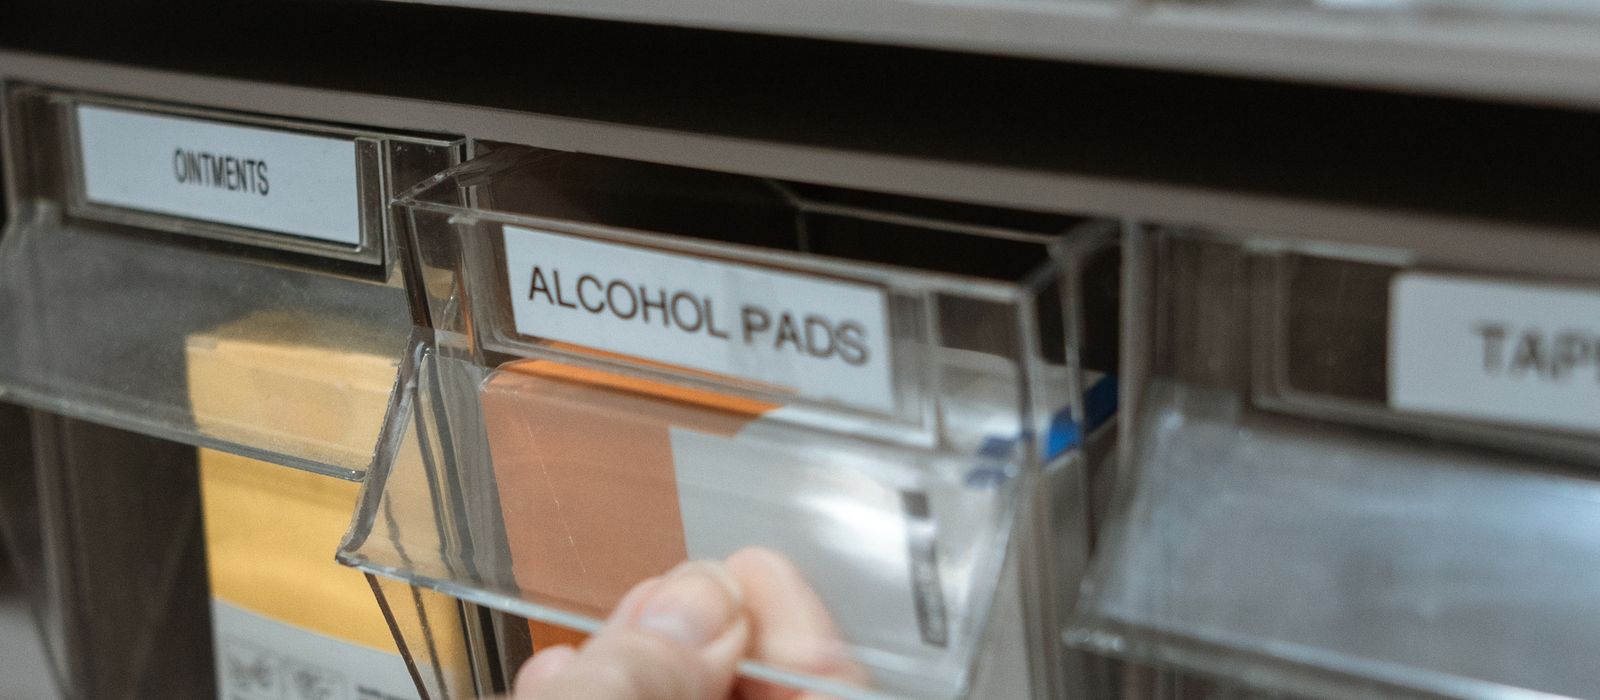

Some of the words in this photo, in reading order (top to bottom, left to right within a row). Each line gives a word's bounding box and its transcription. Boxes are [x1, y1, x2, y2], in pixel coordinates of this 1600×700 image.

[173, 147, 270, 197] OINTMENTS
[527, 265, 730, 340] ALCOHOL
[740, 303, 871, 367] PADS
[1475, 321, 1600, 384] TAP
